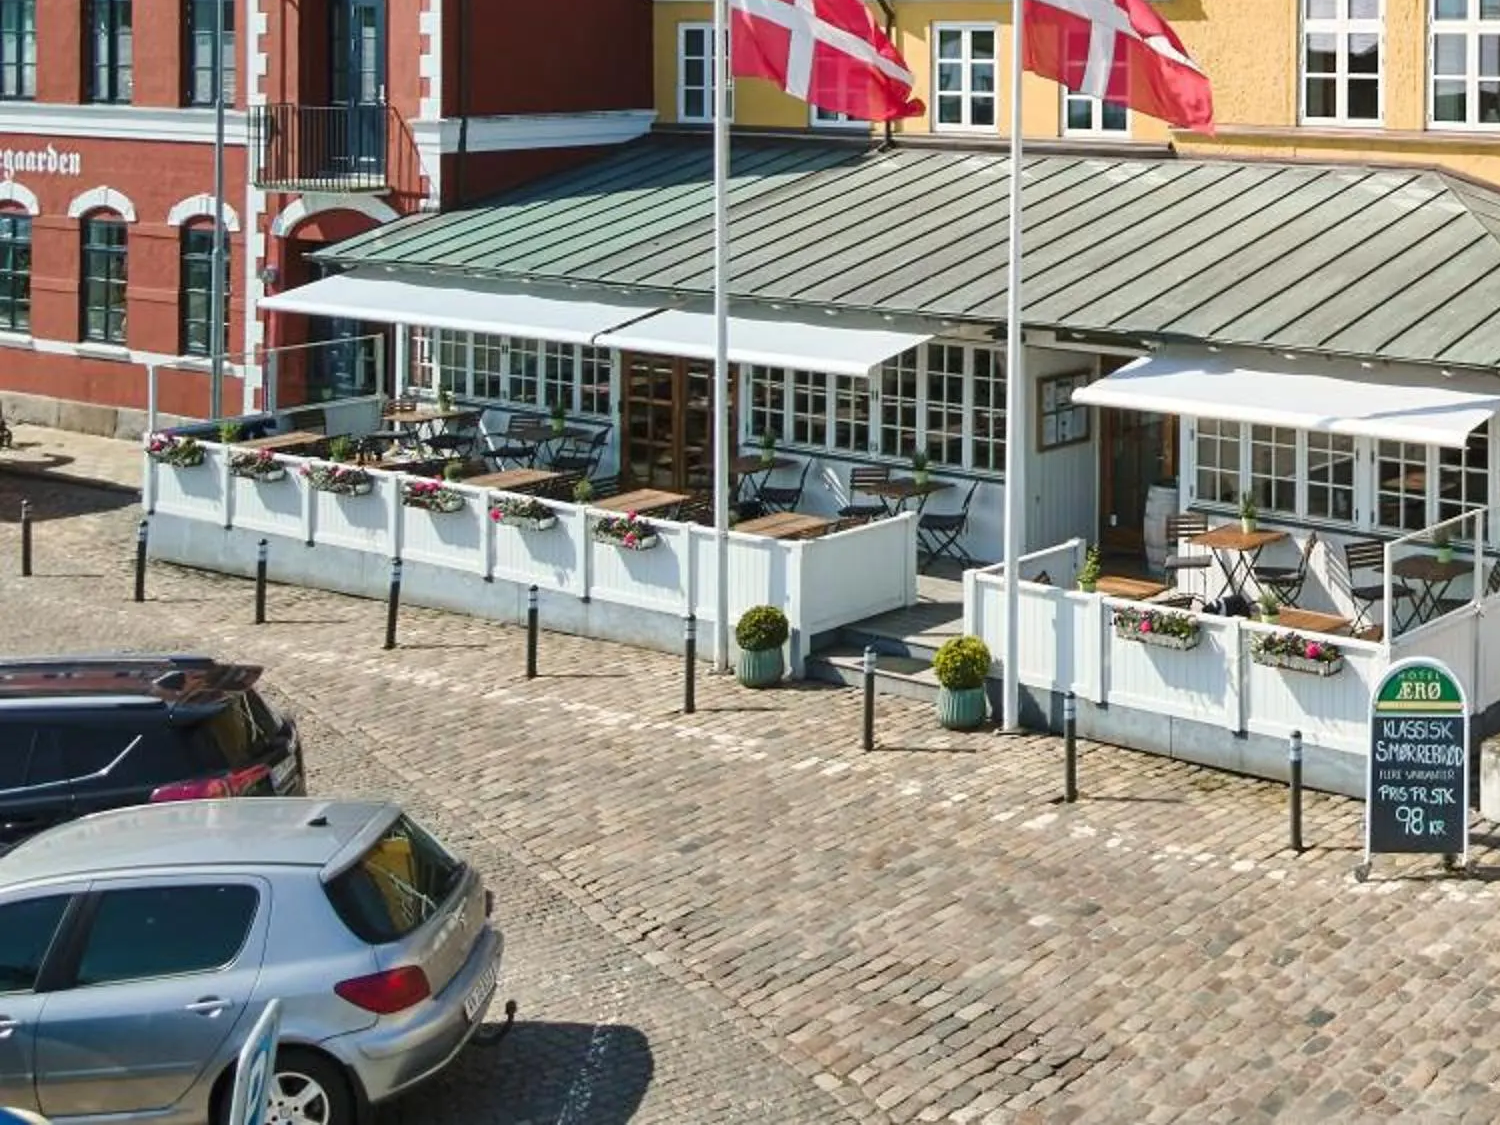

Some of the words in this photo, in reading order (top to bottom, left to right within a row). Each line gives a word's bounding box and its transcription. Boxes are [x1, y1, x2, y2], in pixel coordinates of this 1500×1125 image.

[0, 142, 81, 180] gaarden
[1395, 681, 1441, 700] ÆRØ
[1383, 719, 1454, 740] KLASSISK
[1395, 805, 1425, 835] 98
